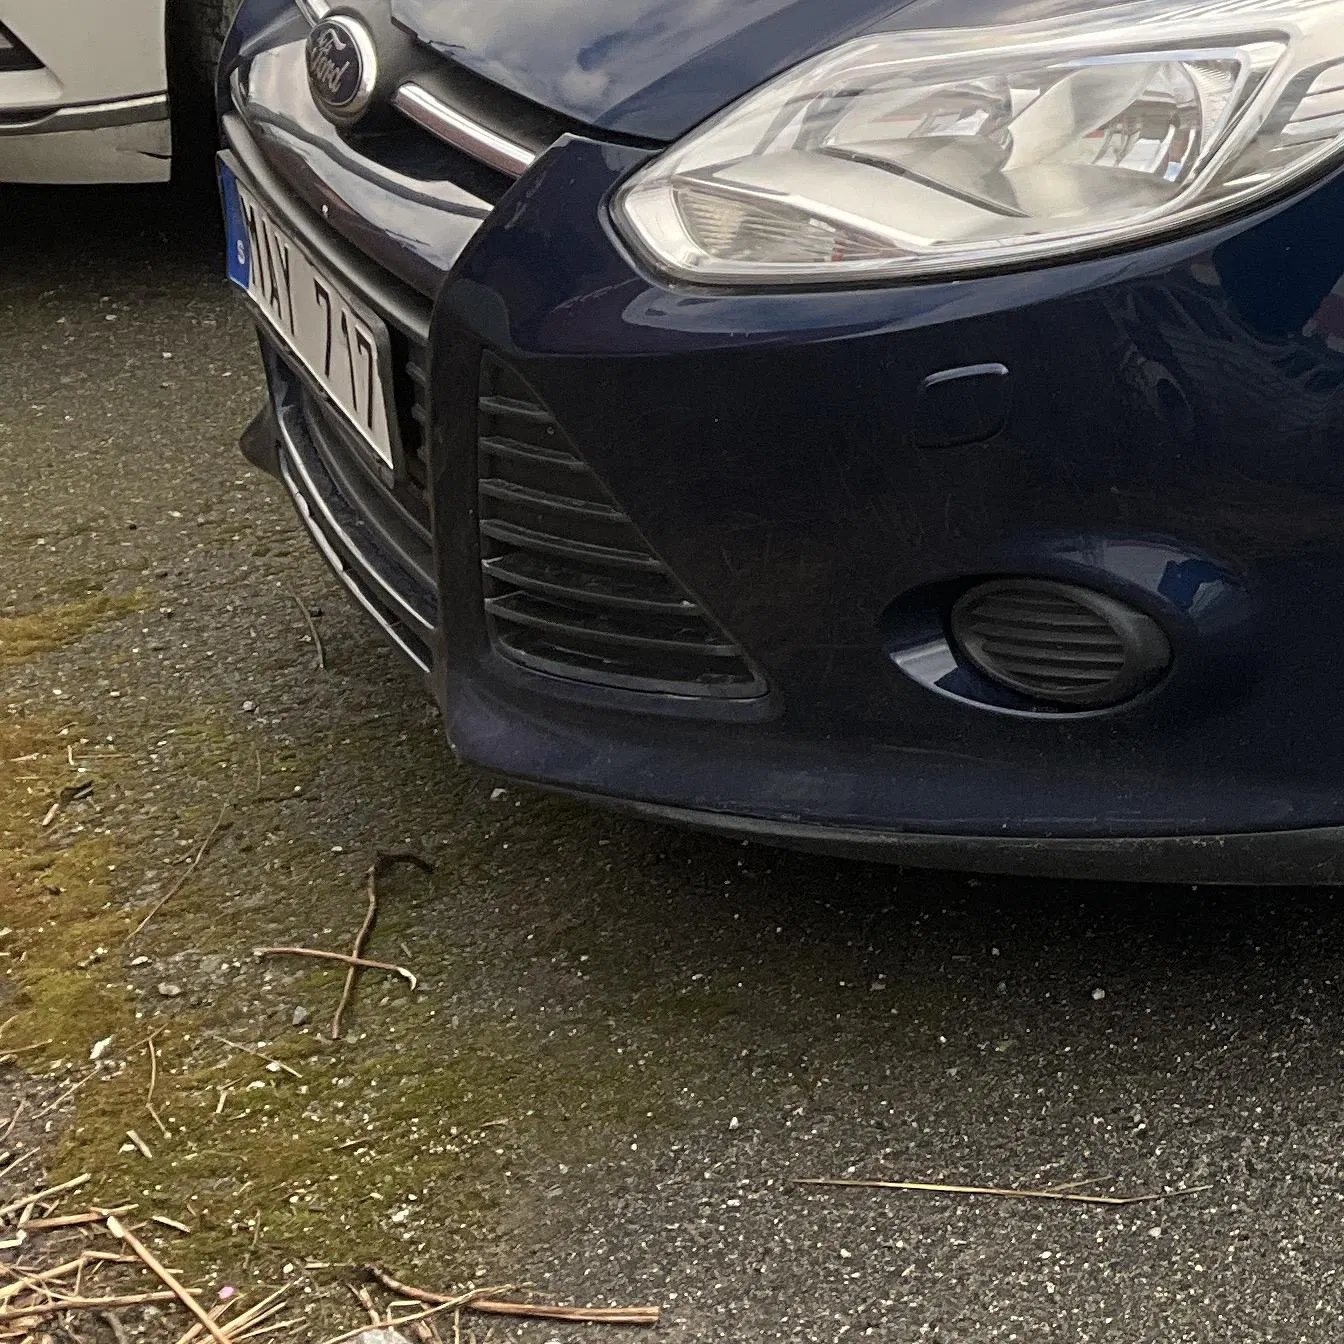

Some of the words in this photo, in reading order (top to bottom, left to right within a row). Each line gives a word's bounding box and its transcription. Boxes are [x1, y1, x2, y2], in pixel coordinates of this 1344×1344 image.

[311, 28, 350, 93] Ford
[236, 238, 246, 265] S
[239, 195, 295, 337] MAY
[314, 277, 374, 431] 717
